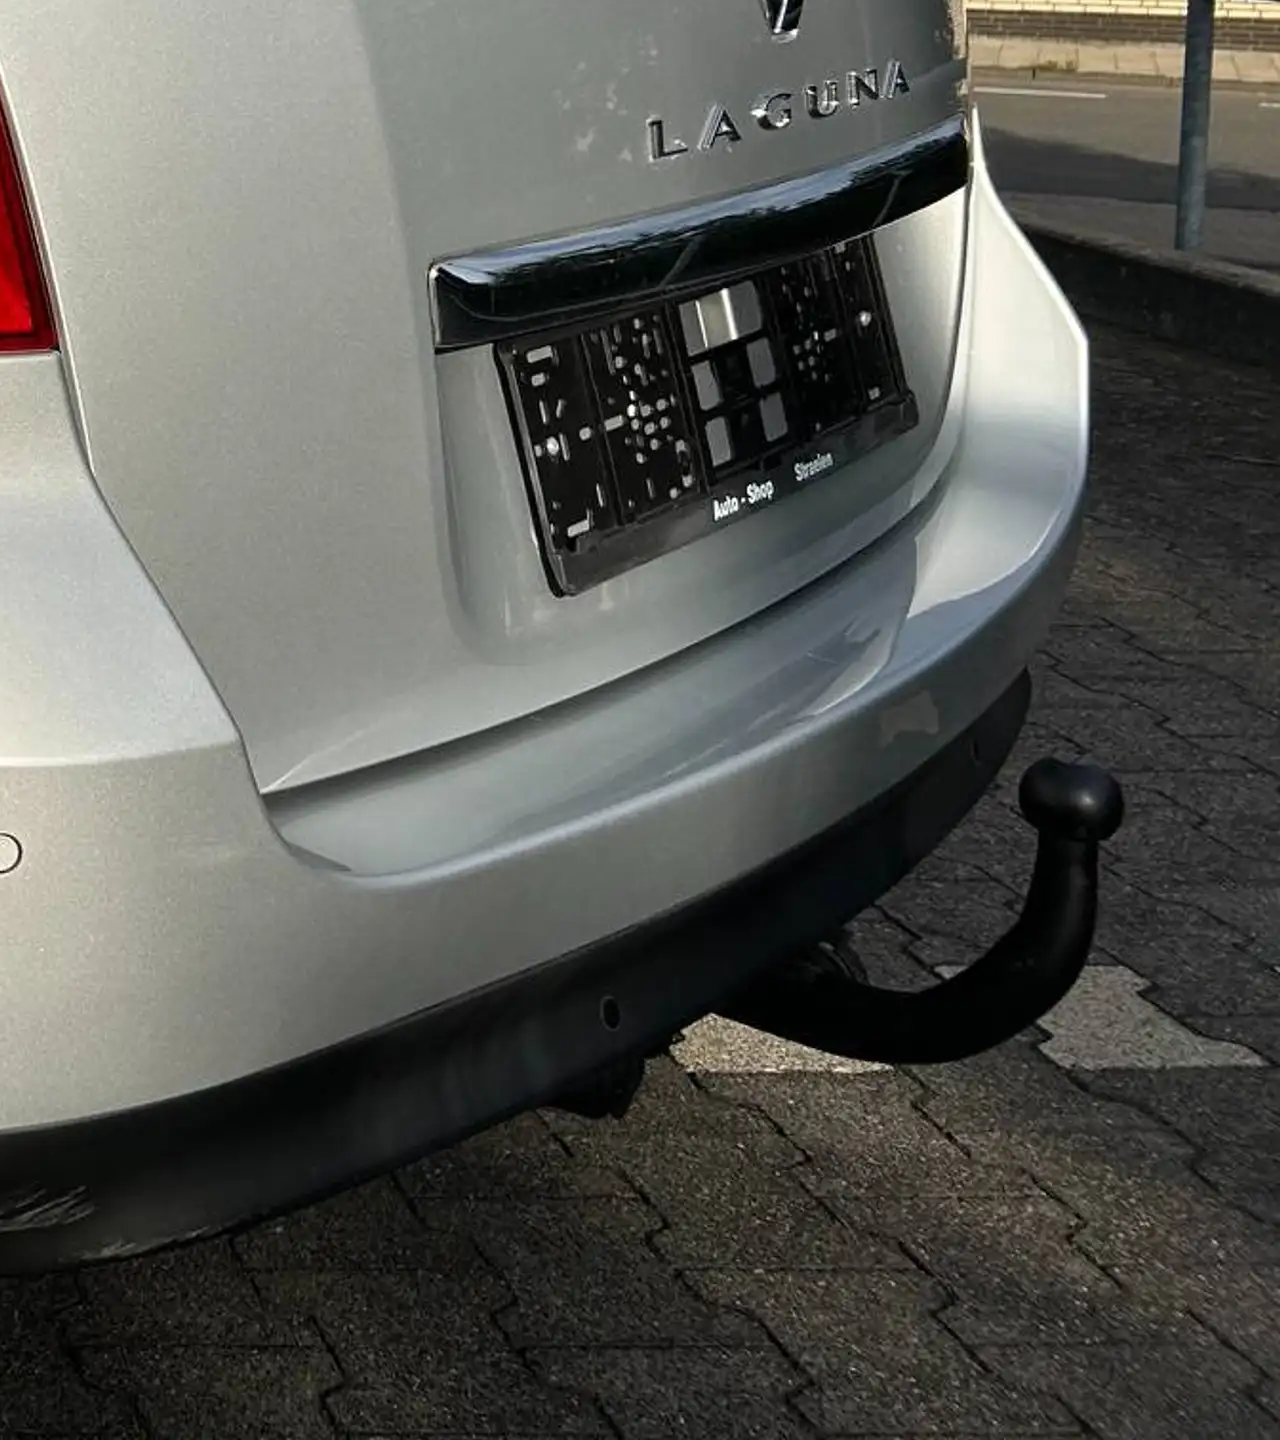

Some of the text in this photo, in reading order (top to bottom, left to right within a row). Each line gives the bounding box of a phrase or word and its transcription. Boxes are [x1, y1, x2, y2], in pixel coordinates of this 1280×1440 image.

[646, 58, 910, 161] LAGUNA
[713, 496, 739, 521] Auto
[746, 480, 775, 504] Shop
